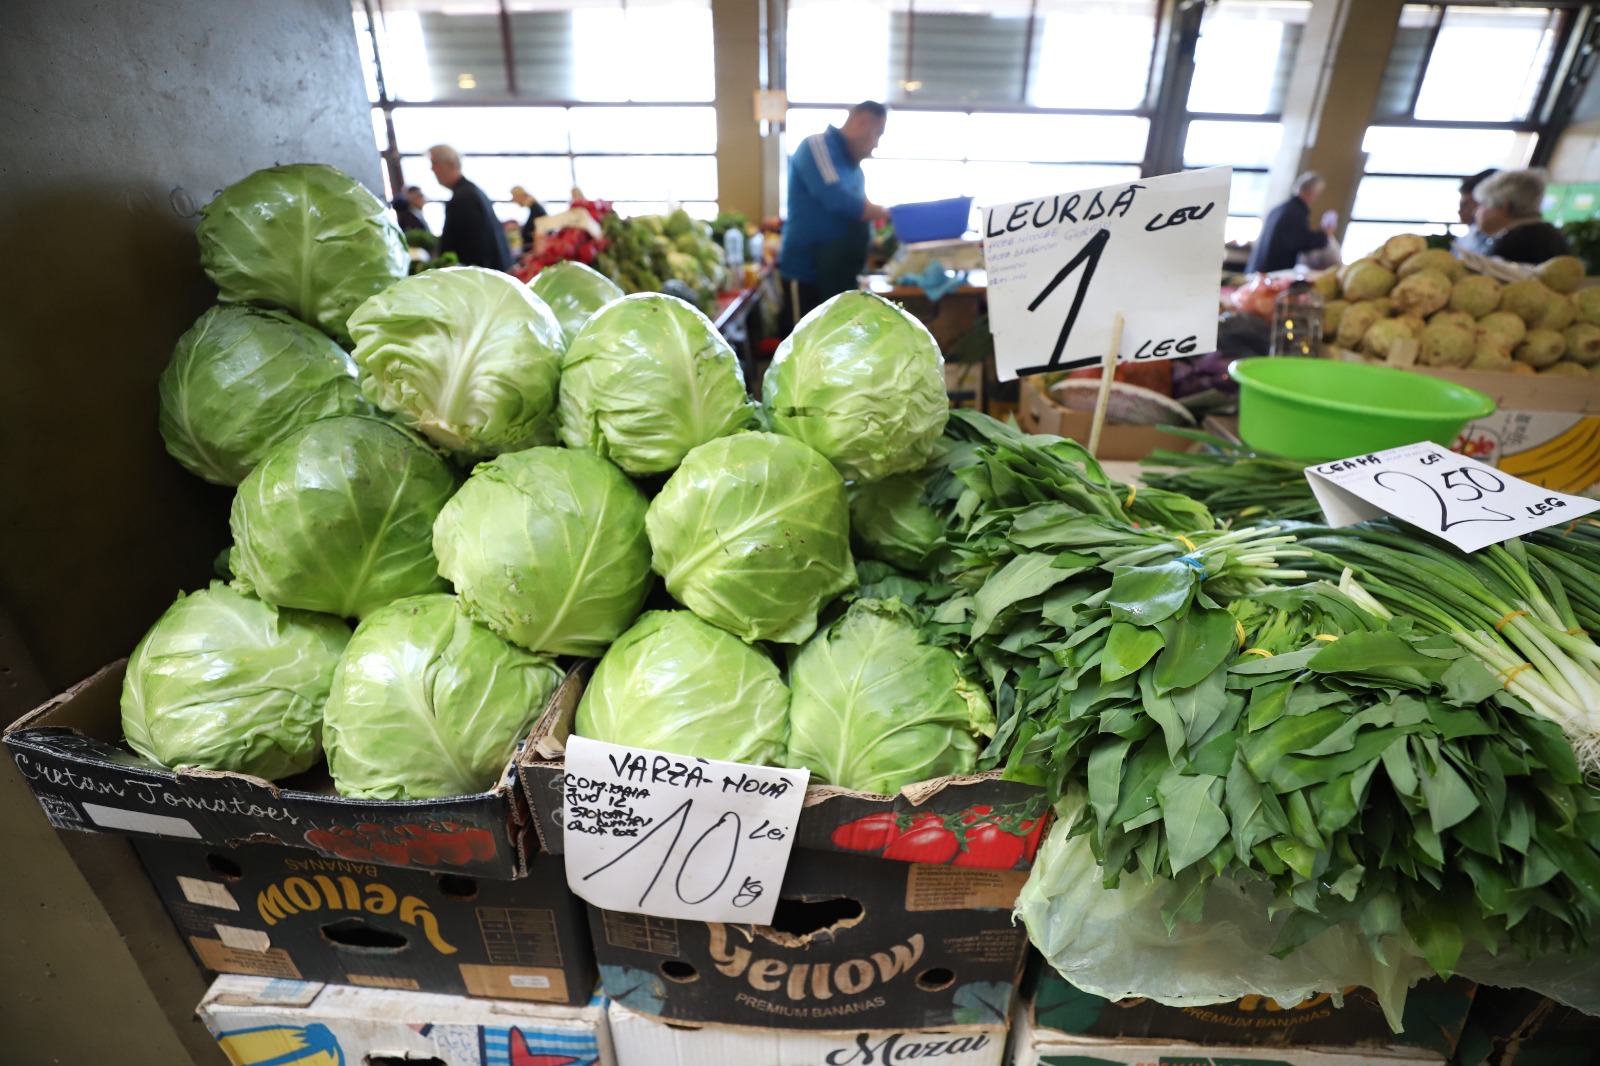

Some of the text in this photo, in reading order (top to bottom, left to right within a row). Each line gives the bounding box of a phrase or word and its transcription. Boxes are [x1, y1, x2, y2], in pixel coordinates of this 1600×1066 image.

[1145, 201, 1215, 232] LEU
[1016, 228, 1110, 377] 1
[1135, 335, 1198, 360] LEG
[1525, 496, 1568, 516] LEG
[14, 753, 125, 798] Cretan
[124, 779, 299, 825] Tomatoes
[582, 798, 741, 908] 10
[284, 858, 378, 877] BANANAS
[735, 993, 886, 1018] PREMIUM BANANAS
[1256, 1009, 1332, 1028] BANANAS
